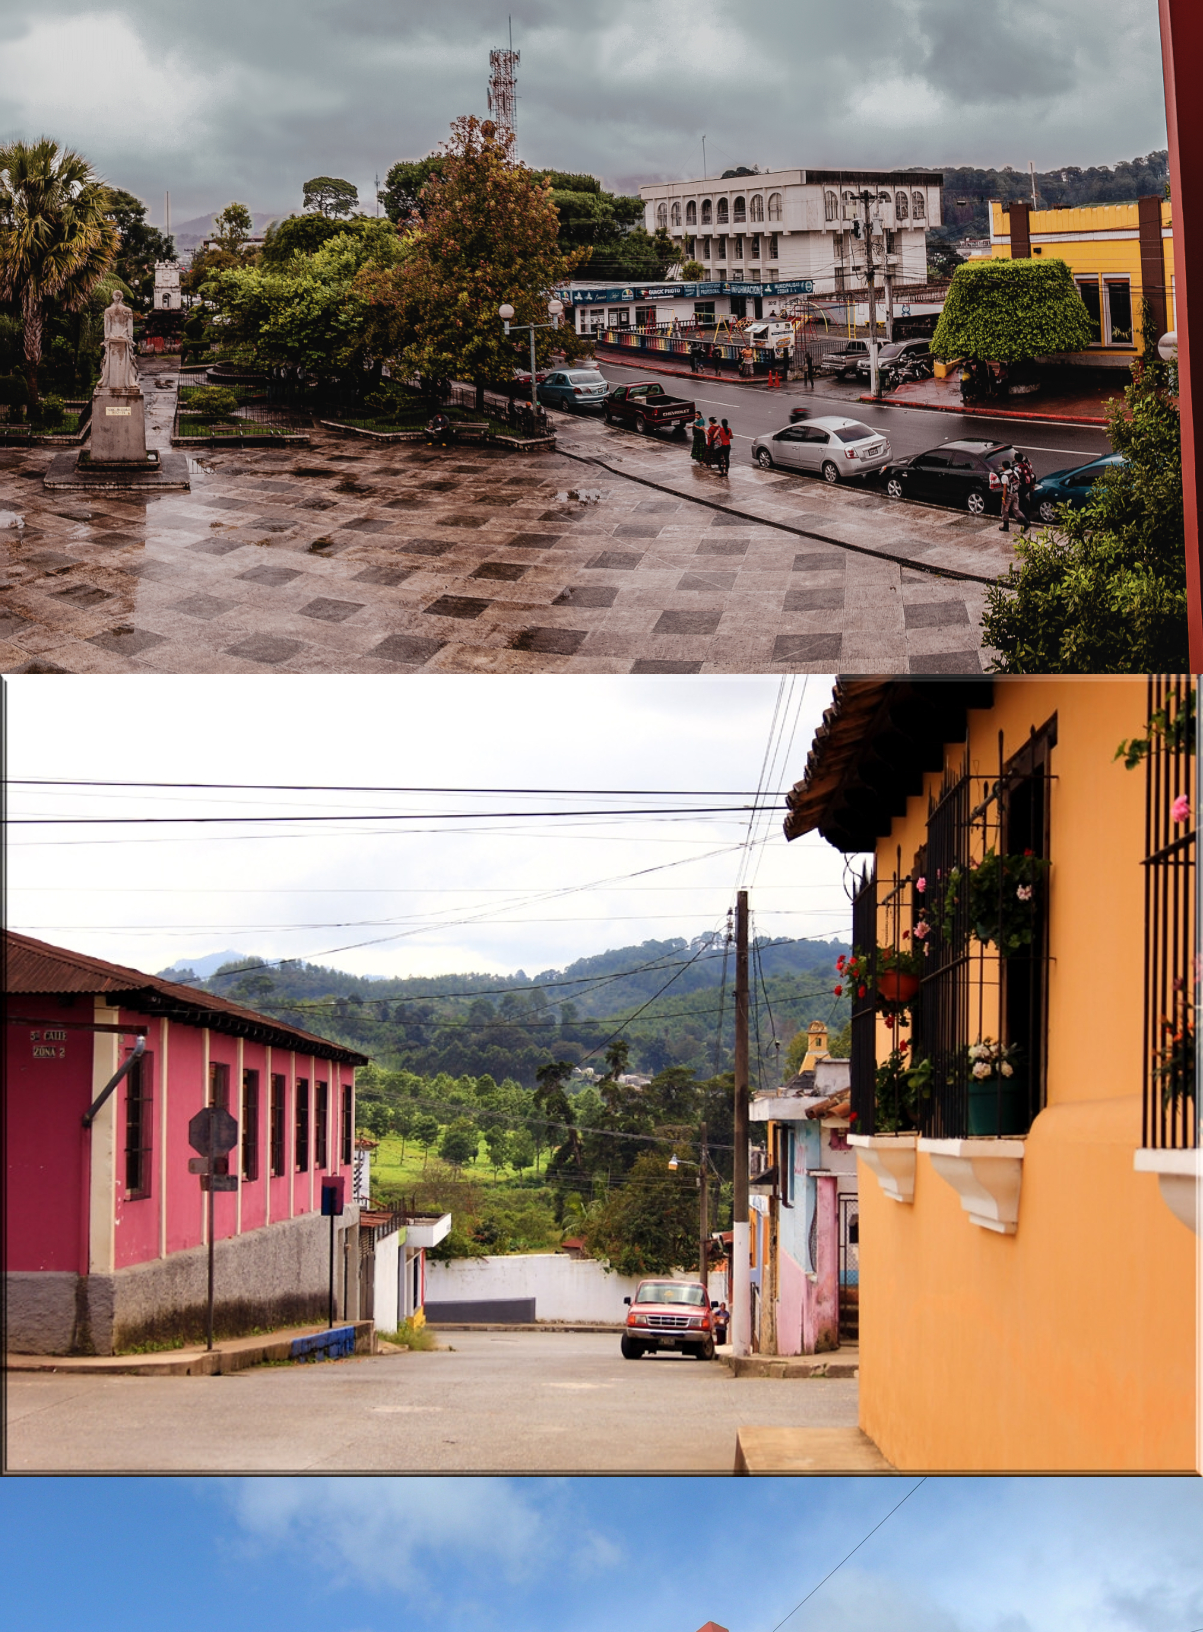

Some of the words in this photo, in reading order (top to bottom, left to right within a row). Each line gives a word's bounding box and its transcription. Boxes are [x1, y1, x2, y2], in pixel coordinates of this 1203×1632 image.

[663, 408, 690, 416] CHEVROLET
[34, 1046, 56, 1058] ZONA
[60, 1047, 66, 1058] 2
